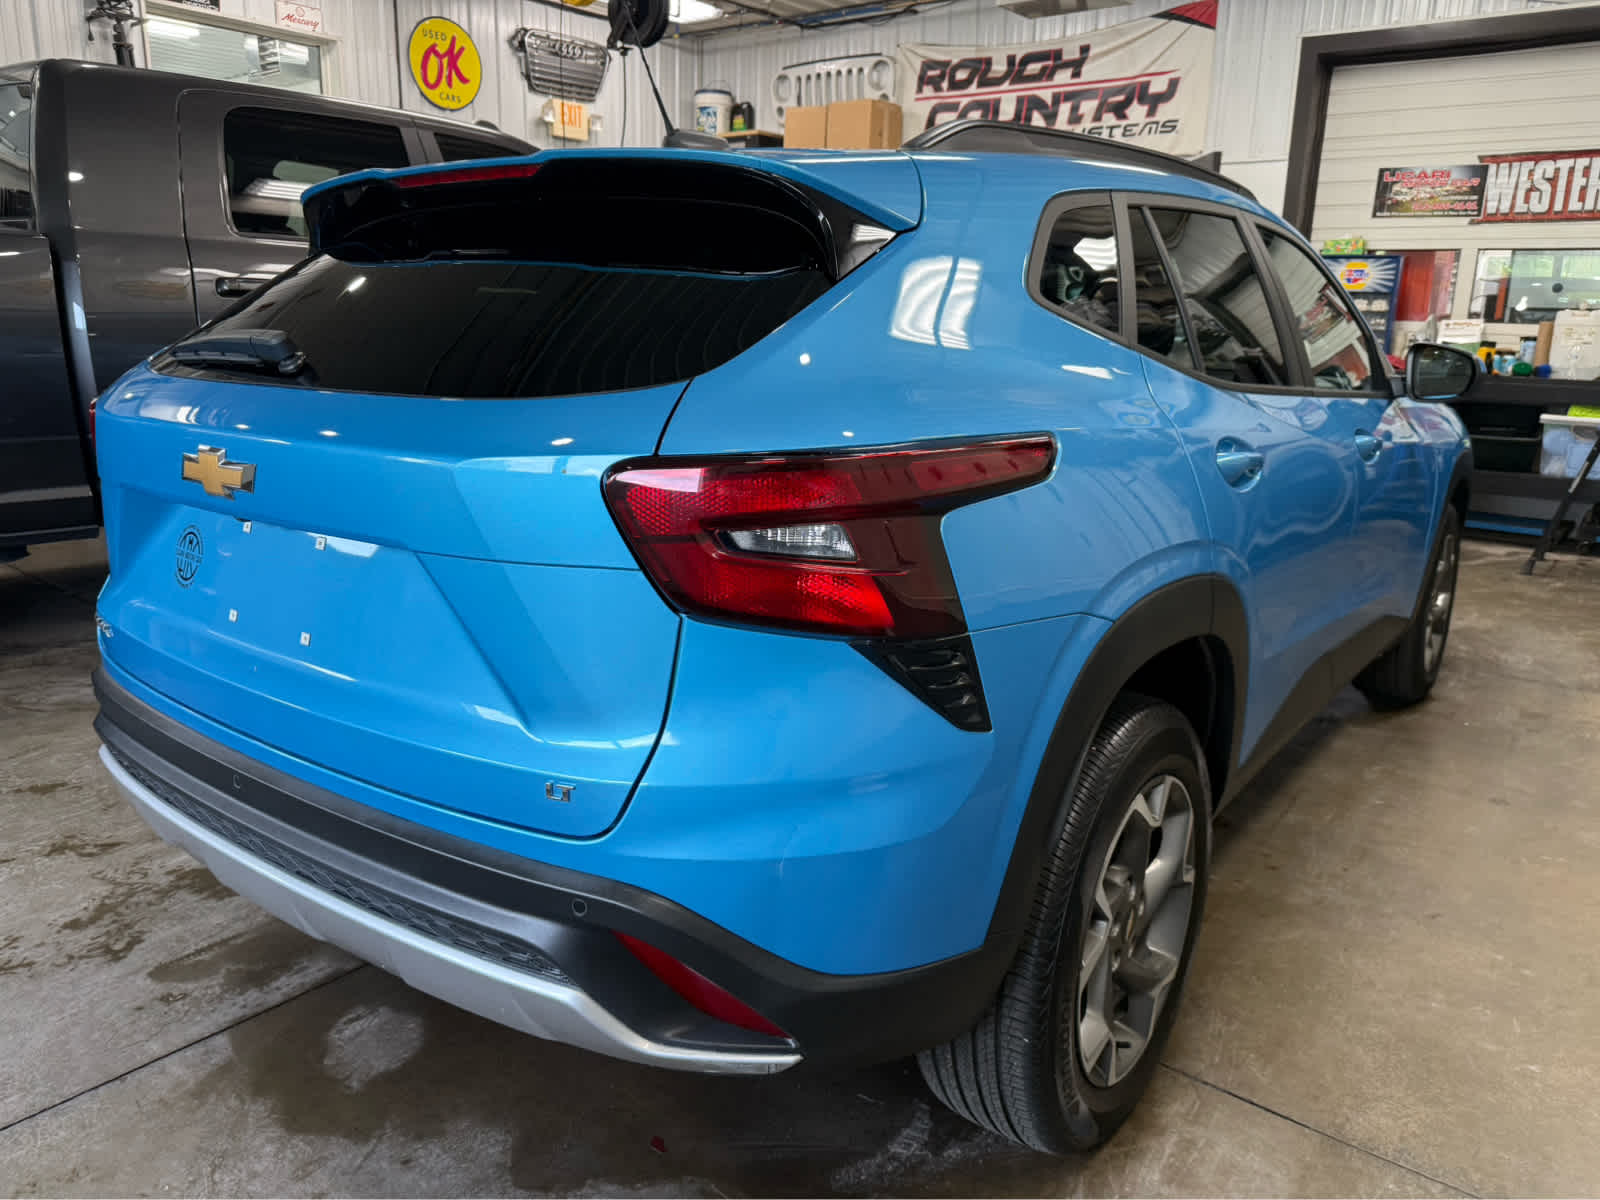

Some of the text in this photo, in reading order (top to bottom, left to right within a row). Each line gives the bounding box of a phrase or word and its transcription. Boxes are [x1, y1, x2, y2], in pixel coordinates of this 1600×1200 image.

[281, 13, 320, 30] Mercury
[422, 28, 447, 42] USED
[421, 35, 471, 90] OK
[916, 44, 1091, 94] ROUGH
[440, 92, 462, 104] CARS
[925, 76, 1182, 130] COUNTRY
[561, 102, 583, 129] EXIT
[1081, 119, 1180, 138] STEMS
[545, 782, 576, 803] LT
